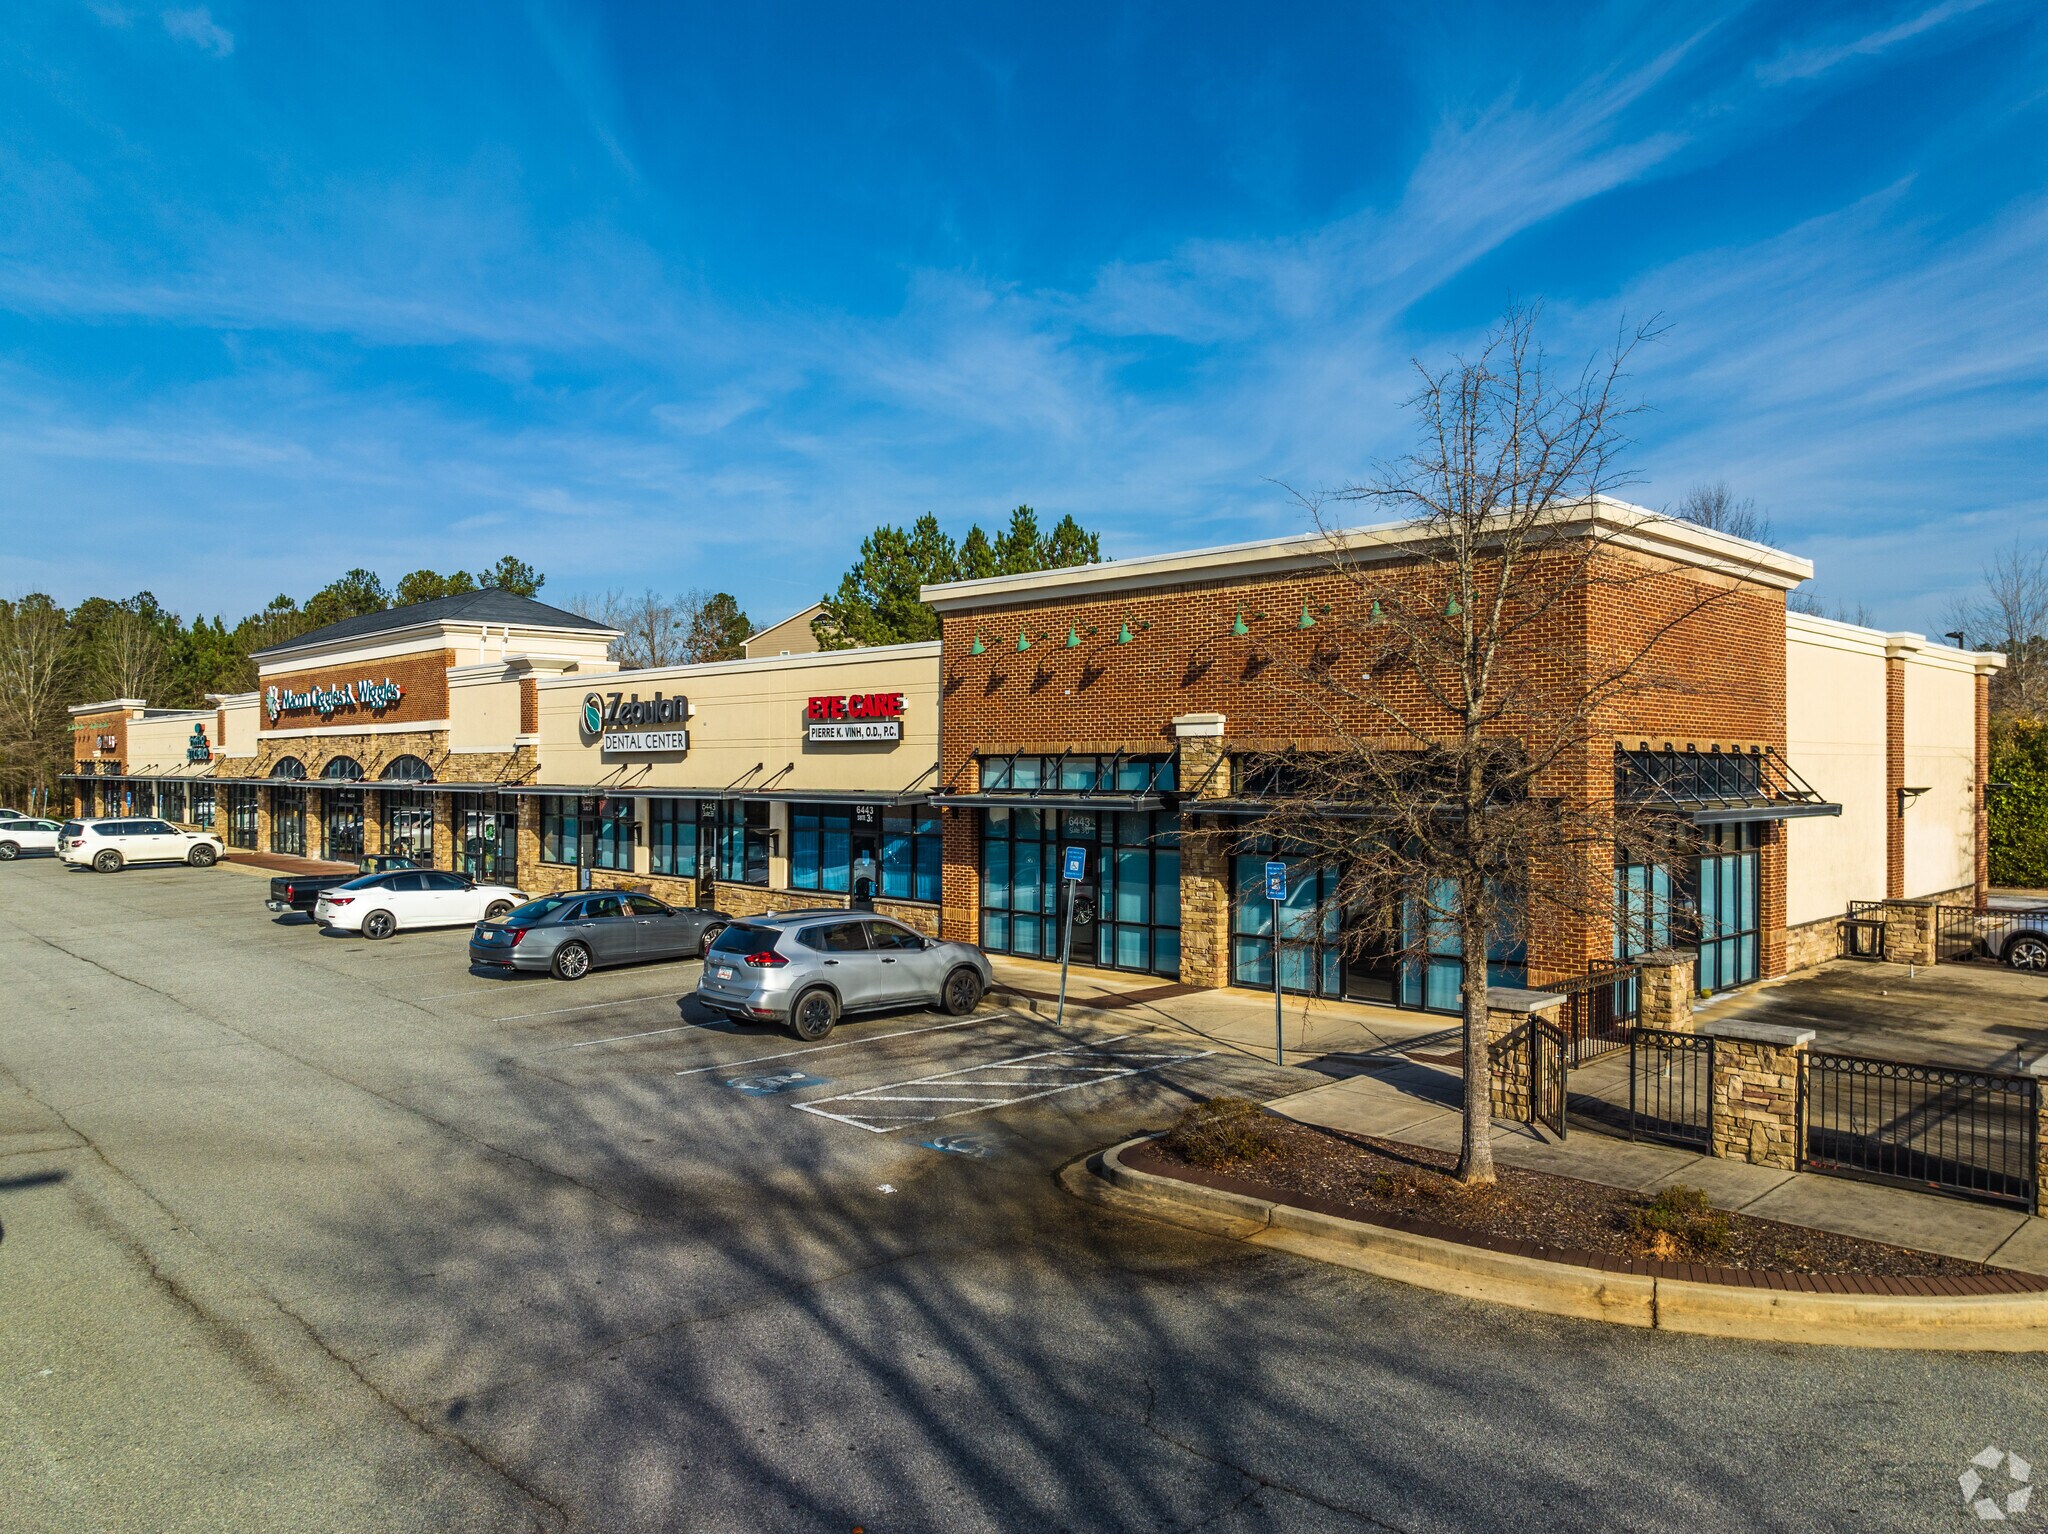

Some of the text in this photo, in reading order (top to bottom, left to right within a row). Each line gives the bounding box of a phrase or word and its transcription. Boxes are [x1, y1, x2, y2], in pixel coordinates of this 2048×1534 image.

[282, 678, 400, 713] Macon Giggles & Wiggles
[606, 692, 689, 726] Zebulon
[808, 692, 902, 719] EYE CARE
[811, 726, 897, 739] PIERRE K. VINH, O.D., P.C.
[605, 733, 684, 749] DENTAL CENTER
[856, 805, 874, 815] 6443
[1068, 816, 1090, 827] 6443
